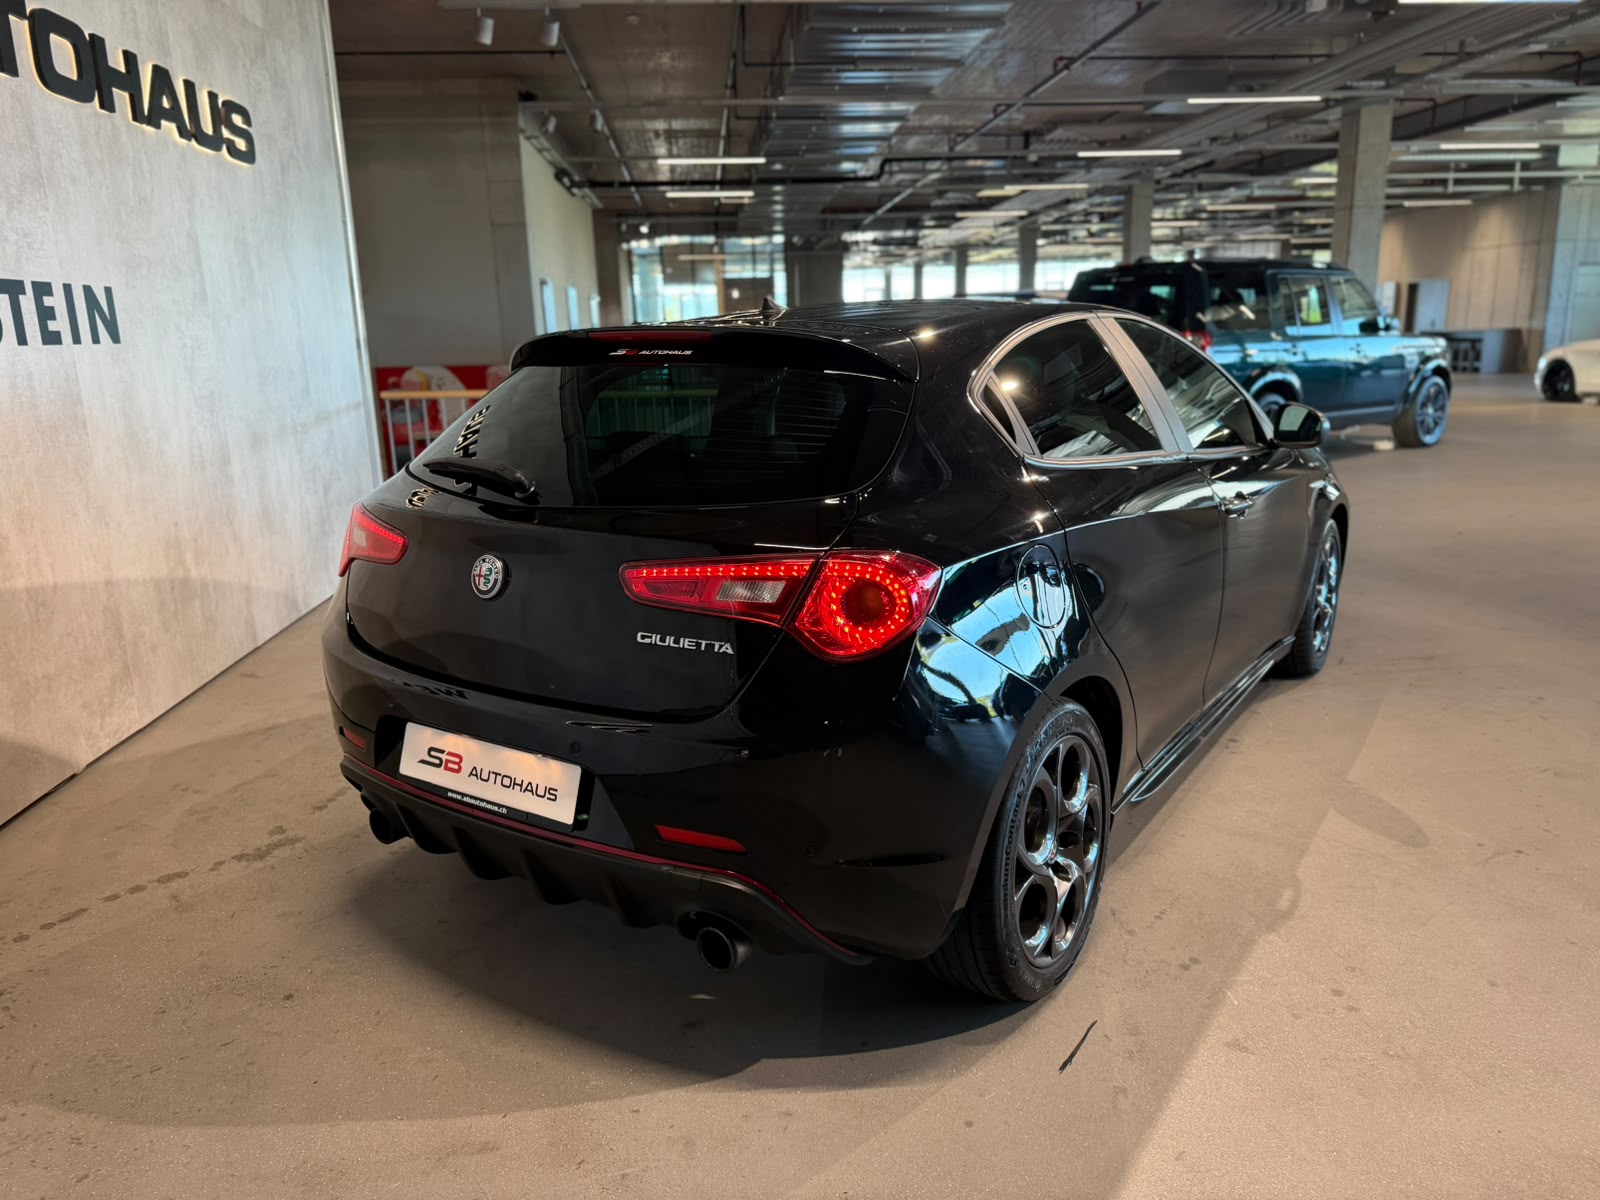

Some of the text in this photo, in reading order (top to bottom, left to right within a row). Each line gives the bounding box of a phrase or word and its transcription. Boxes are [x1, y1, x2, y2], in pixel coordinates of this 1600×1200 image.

[0, 278, 121, 346] TEIN
[636, 631, 735, 655] GIULIETTA
[417, 746, 559, 802] SB AUTOHAUS
[447, 791, 507, 814] www.sbautohaus.ch
